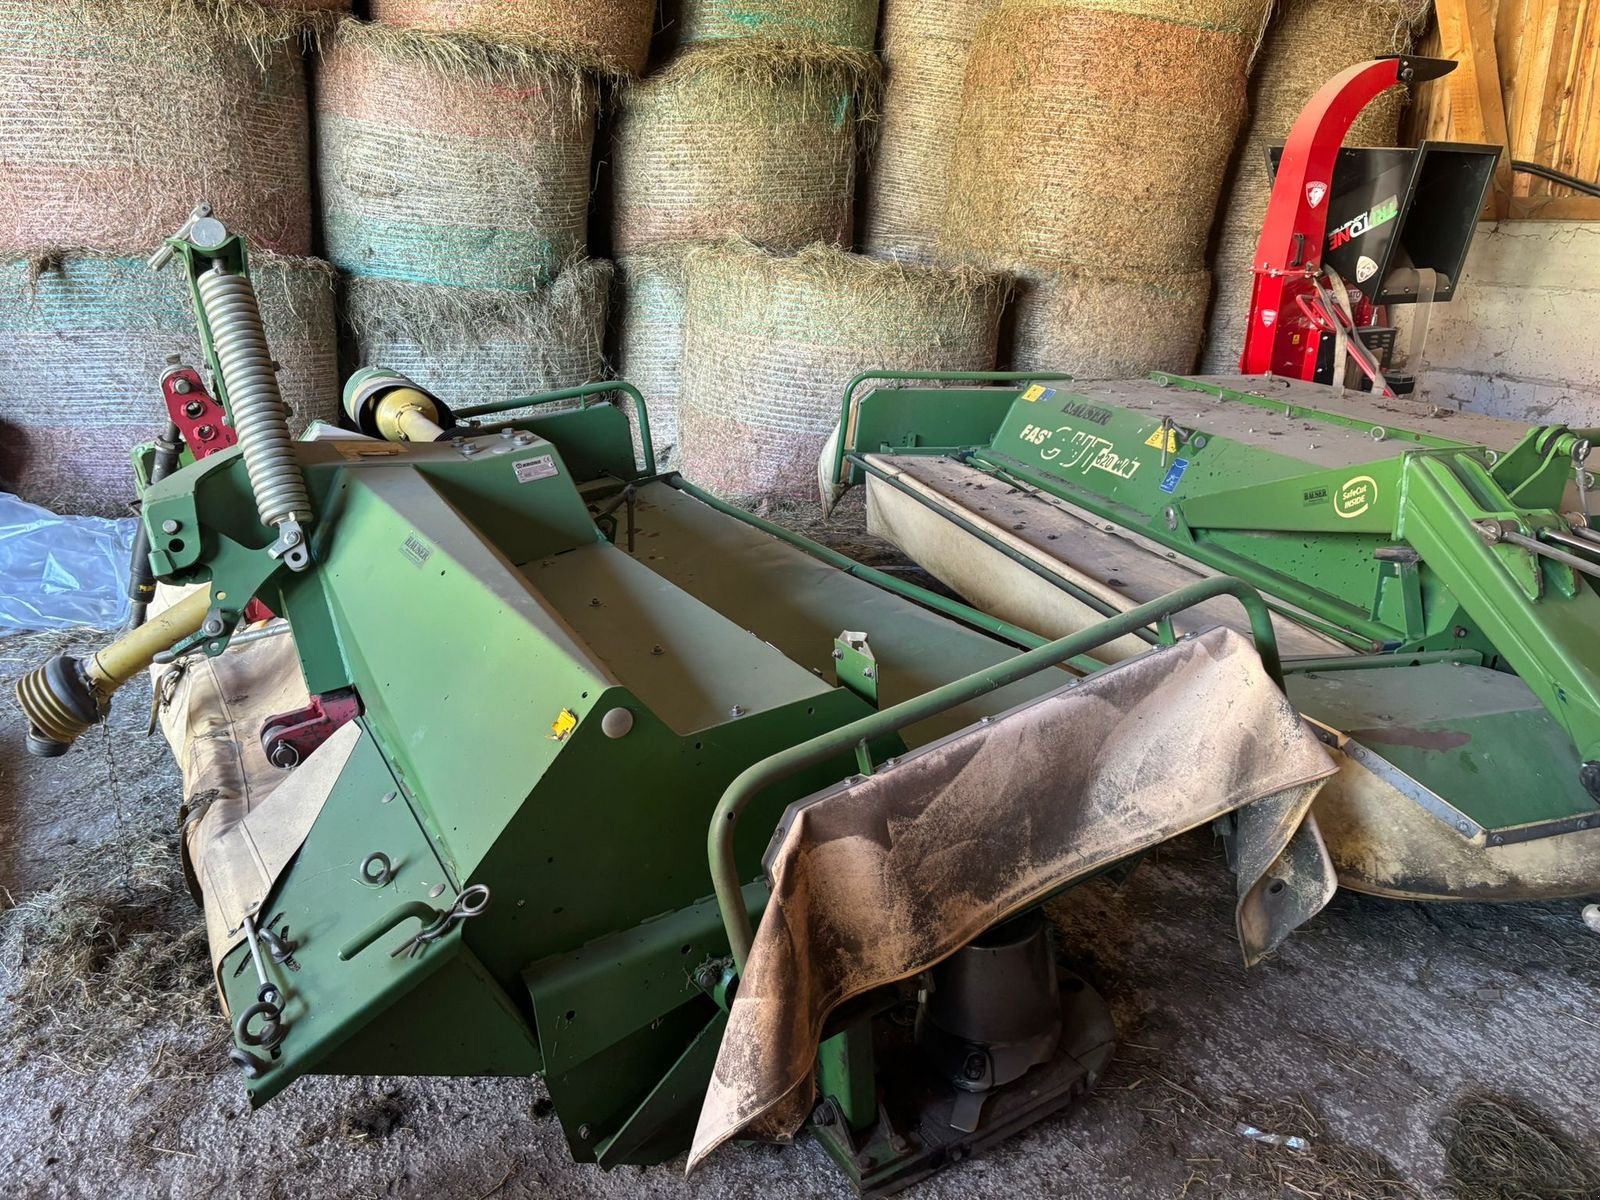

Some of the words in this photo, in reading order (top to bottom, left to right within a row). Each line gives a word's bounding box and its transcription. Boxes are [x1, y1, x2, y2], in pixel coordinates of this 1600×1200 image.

[1342, 484, 1367, 500] SafeCut
[1344, 494, 1366, 509] INSIDE
[404, 536, 430, 560] HAUSER
